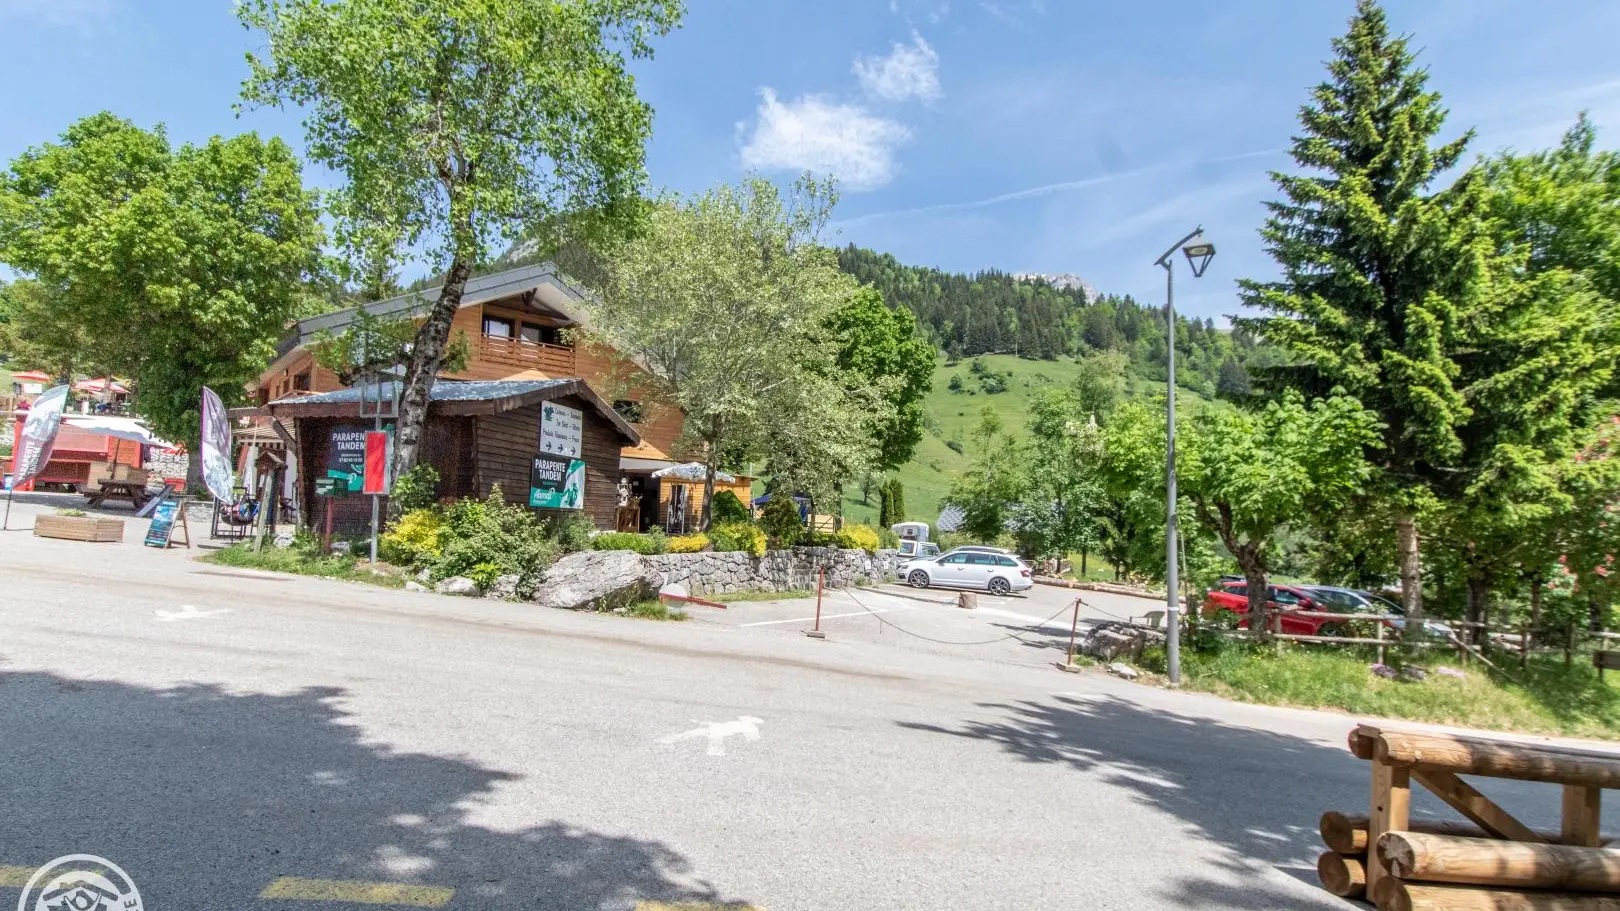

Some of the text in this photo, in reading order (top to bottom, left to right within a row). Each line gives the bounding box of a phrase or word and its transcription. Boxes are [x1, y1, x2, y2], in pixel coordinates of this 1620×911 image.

[333, 432, 365, 441] PARAPEN
[337, 441, 365, 450] TANDEM
[535, 459, 566, 473] PARAPENTE
[539, 469, 562, 482] TANDEM
